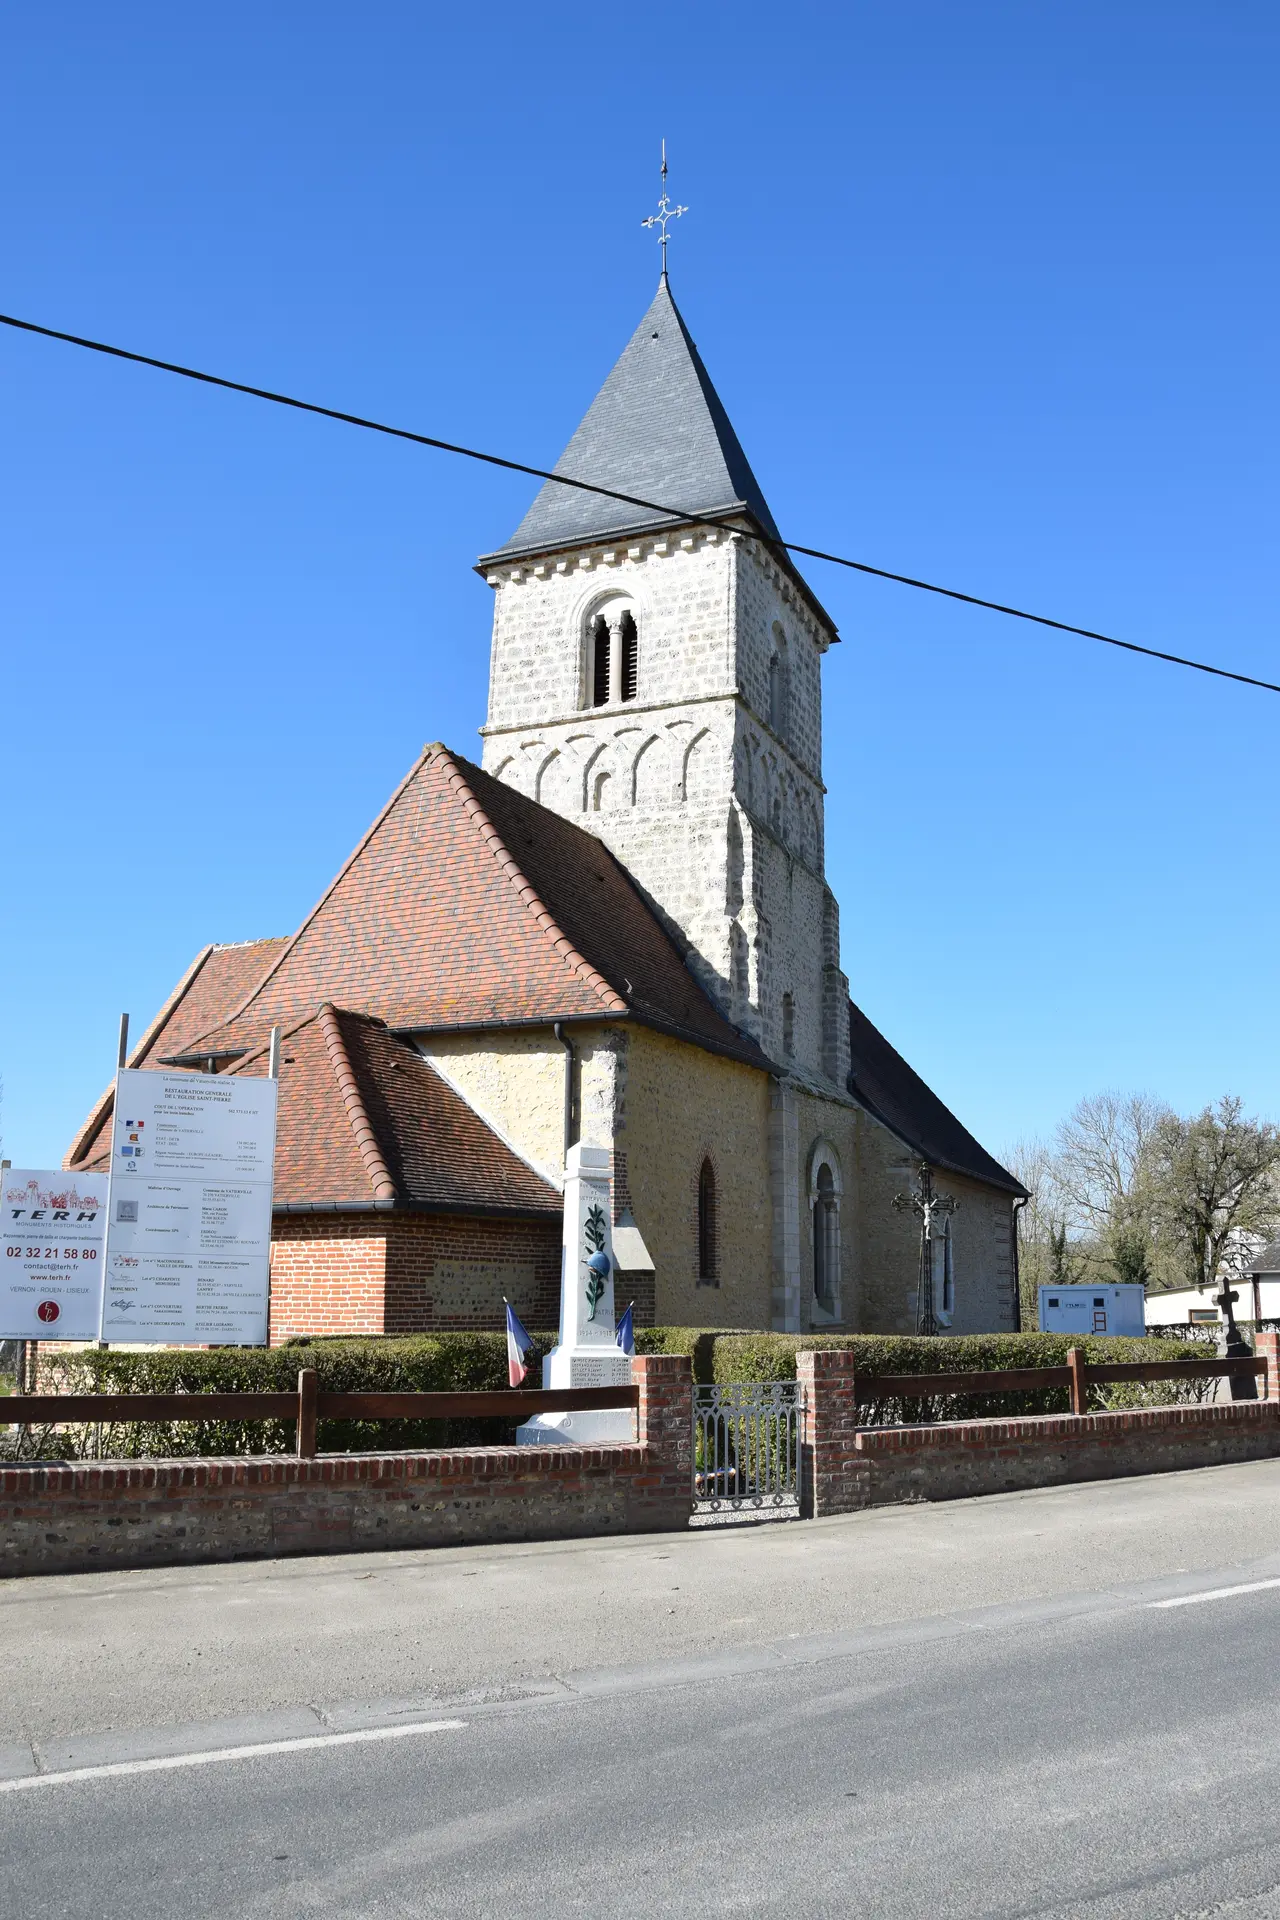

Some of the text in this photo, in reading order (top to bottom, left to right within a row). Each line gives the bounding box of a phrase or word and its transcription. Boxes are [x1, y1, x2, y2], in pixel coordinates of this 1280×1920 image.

[11, 1209, 98, 1222] TERH
[7, 1246, 97, 1260] 02 32 21 58 80
[23, 1263, 79, 1271] contact@terh.fr
